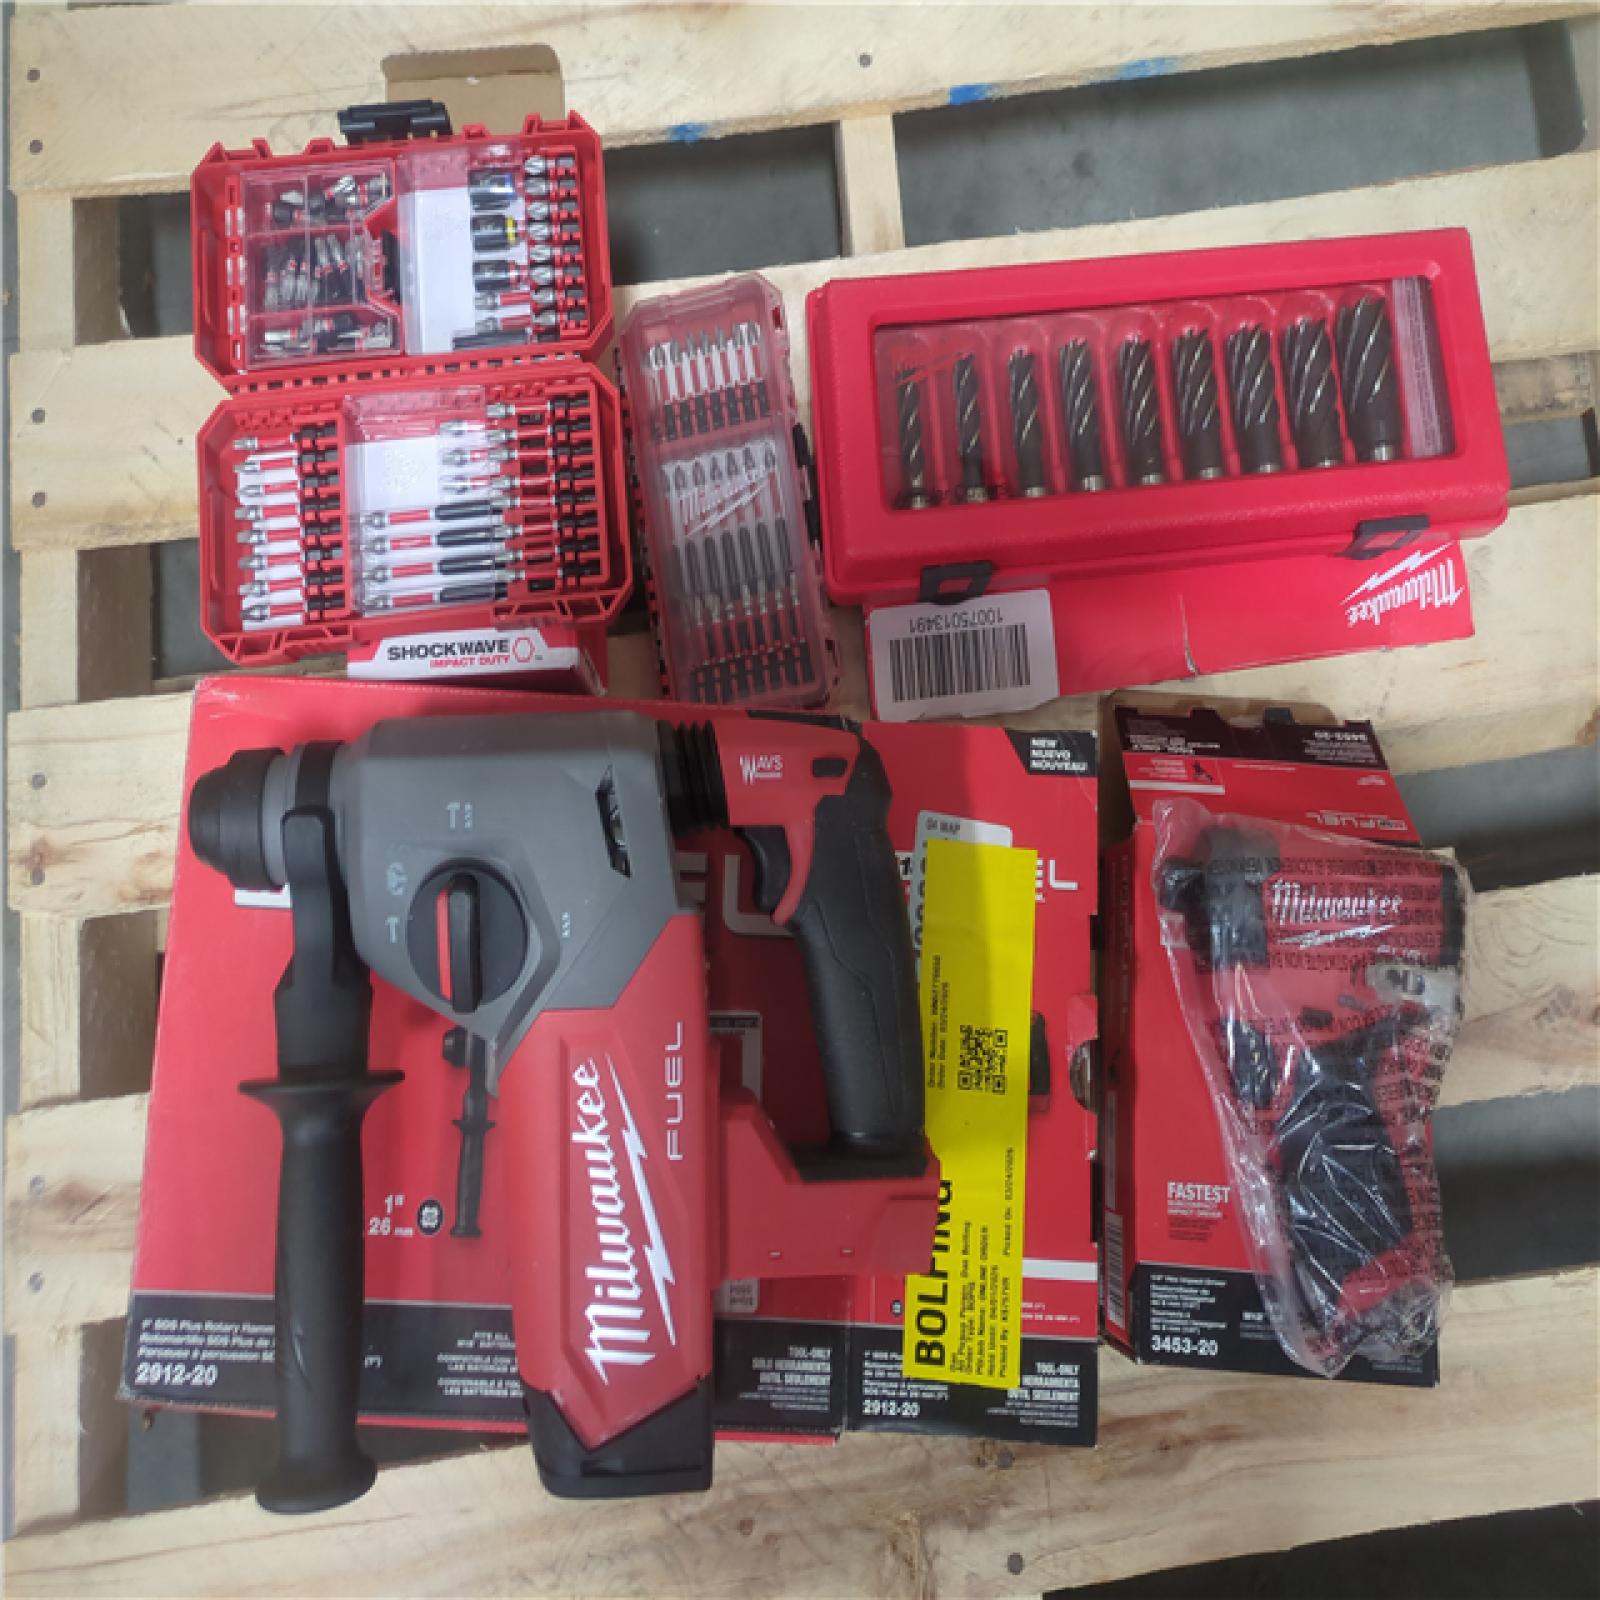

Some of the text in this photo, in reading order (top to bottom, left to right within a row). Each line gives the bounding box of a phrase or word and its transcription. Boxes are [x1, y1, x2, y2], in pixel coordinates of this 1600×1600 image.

[1345, 558, 1465, 627] Milwaukee
[910, 608, 1003, 633] 10075013491
[387, 639, 510, 661] SHOCKWAVE
[430, 655, 510, 668] IMPACT DUTY
[1271, 879, 1403, 922] Milwaukee
[665, 1022, 683, 1160] FUEL
[1167, 1181, 1230, 1203] FASTEST
[368, 1216, 391, 1236] 26
[572, 1056, 655, 1386] Milwaukee
[1151, 1335, 1218, 1356] 3453-20
[134, 1361, 218, 1386] 2912-20
[863, 1399, 920, 1418] 2912-20
